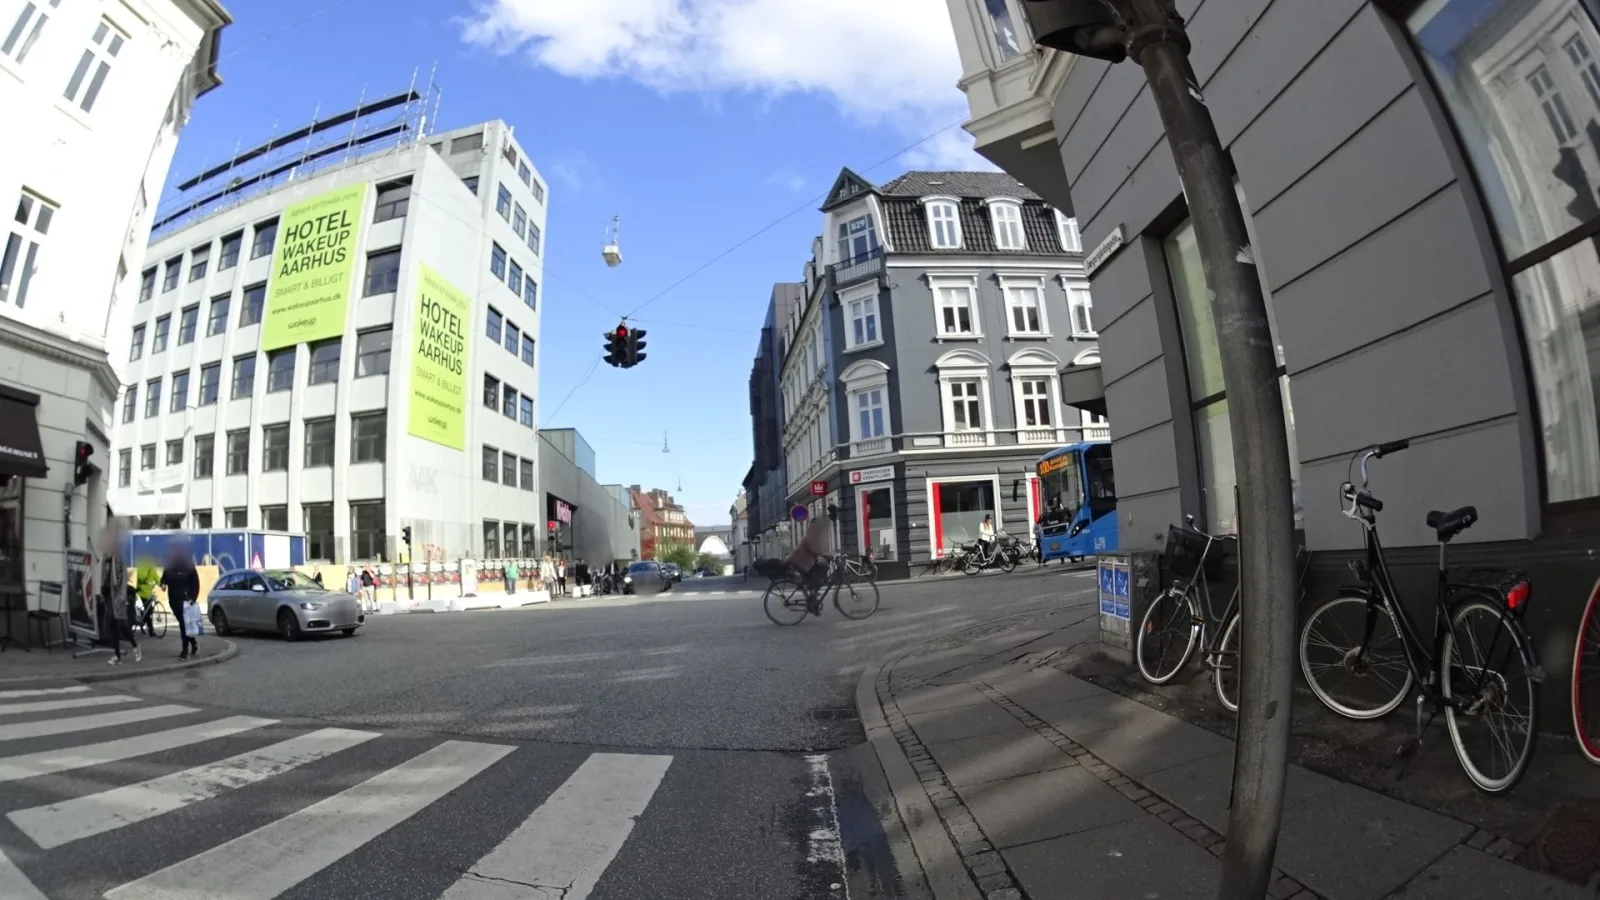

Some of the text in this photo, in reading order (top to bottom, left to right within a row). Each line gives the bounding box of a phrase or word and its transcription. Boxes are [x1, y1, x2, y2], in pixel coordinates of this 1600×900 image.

[284, 210, 352, 245] HOTEL
[283, 230, 350, 261] WAKEUP
[279, 247, 347, 279] AARHUS
[275, 272, 344, 298] SMART & BILLIGT
[272, 293, 341, 315] www.wakeupaarhus.dk
[421, 293, 464, 340] HOTEL
[420, 317, 464, 356] WAKEUP
[418, 339, 463, 375] AARHUS
[416, 366, 436, 383] SMART
[442, 379, 462, 396] BILLIGT
